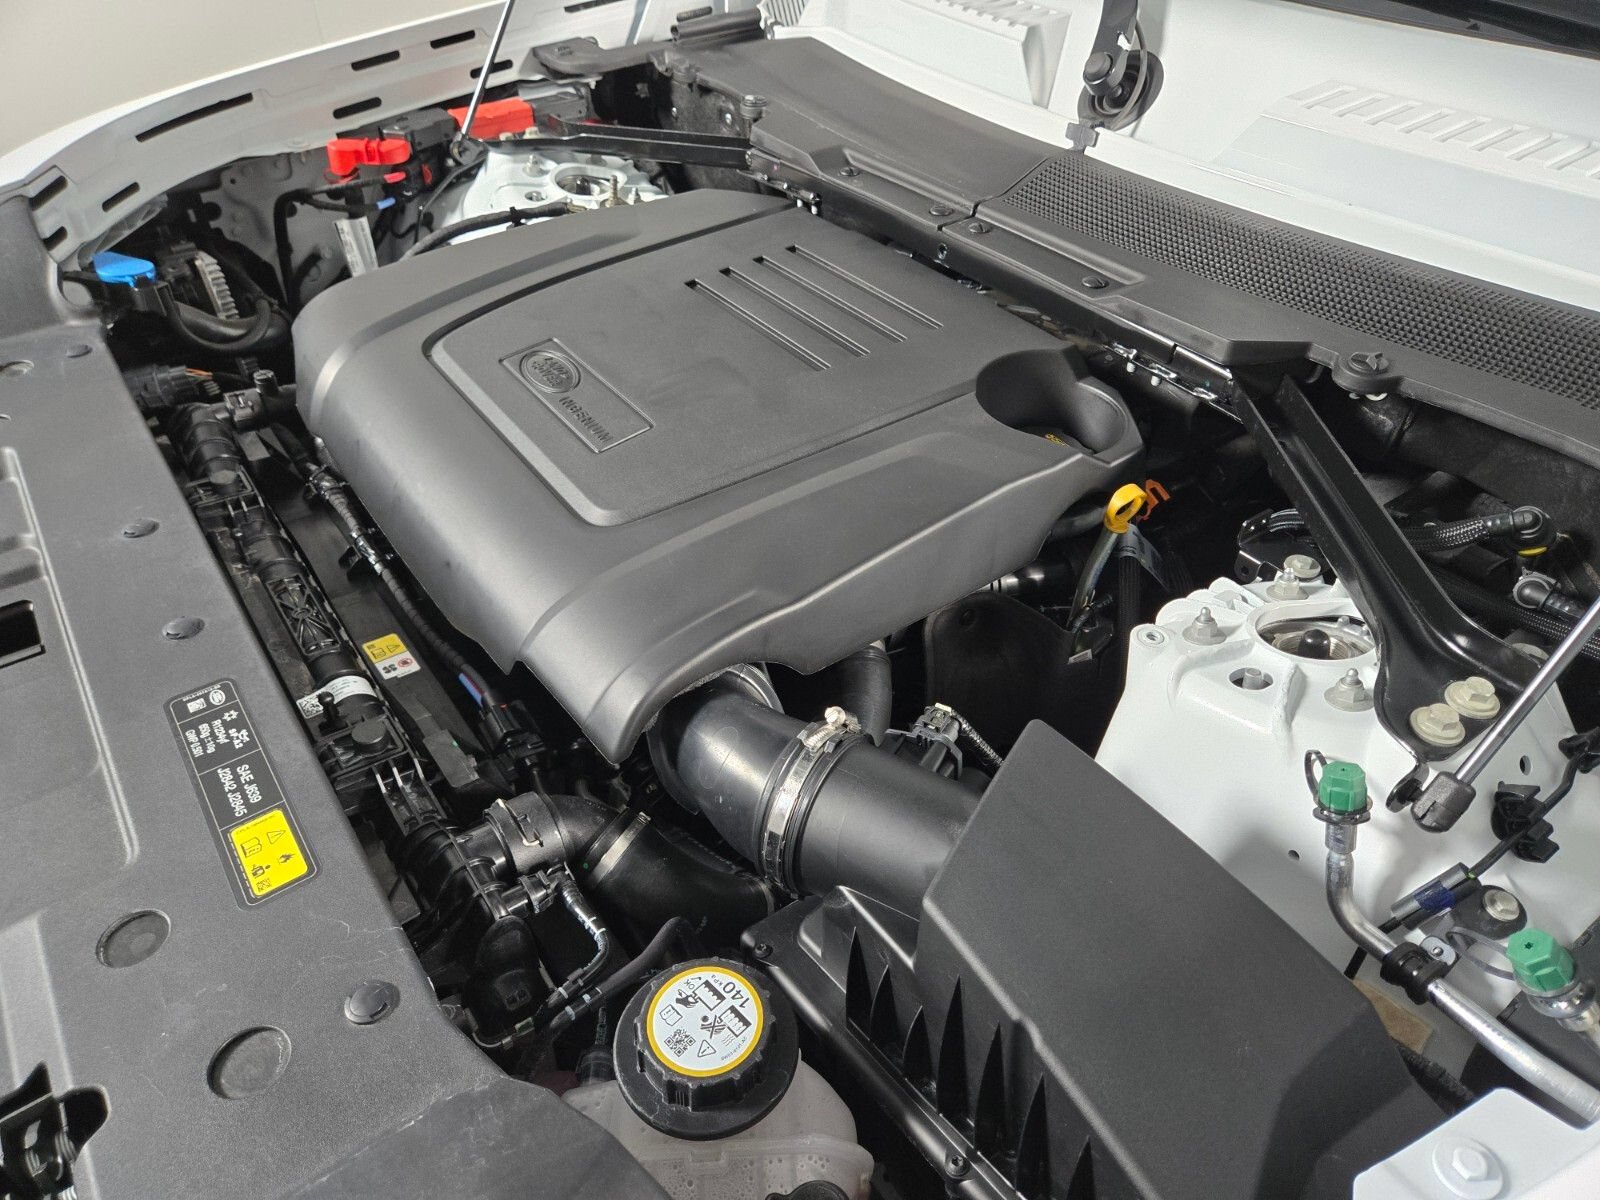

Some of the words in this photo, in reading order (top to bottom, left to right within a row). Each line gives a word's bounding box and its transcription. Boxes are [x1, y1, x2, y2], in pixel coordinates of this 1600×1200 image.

[559, 396, 614, 442] INGENIUM
[185, 729, 199, 743] GWP
[211, 719, 230, 744] R1234yf
[236, 764, 254, 784] SAE
[217, 767, 237, 792] J2842
[227, 791, 248, 817] J2845
[243, 783, 262, 804] J639
[685, 979, 695, 990] OK
[711, 974, 723, 987] kPa
[722, 981, 750, 1009] 140
